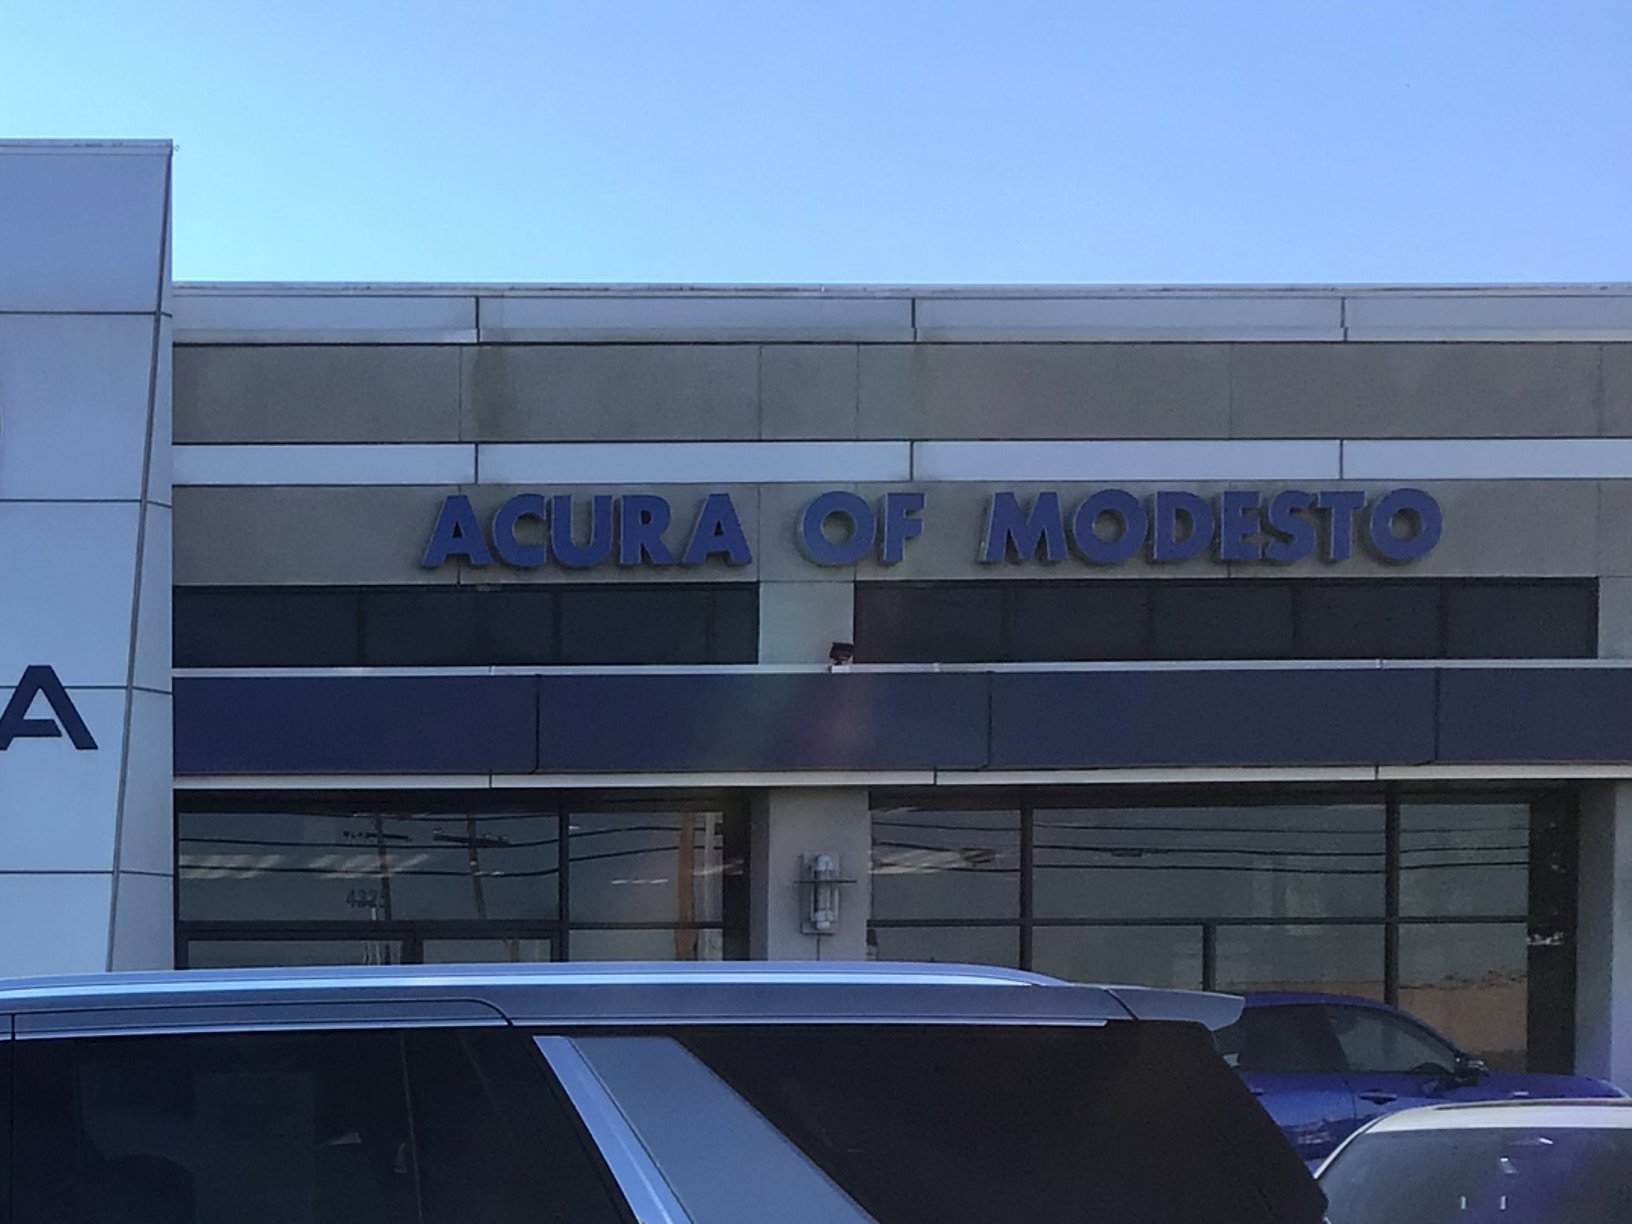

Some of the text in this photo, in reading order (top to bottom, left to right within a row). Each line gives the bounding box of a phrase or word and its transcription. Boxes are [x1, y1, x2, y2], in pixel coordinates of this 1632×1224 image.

[421, 488, 1444, 567] ACURA OF MODESTO
